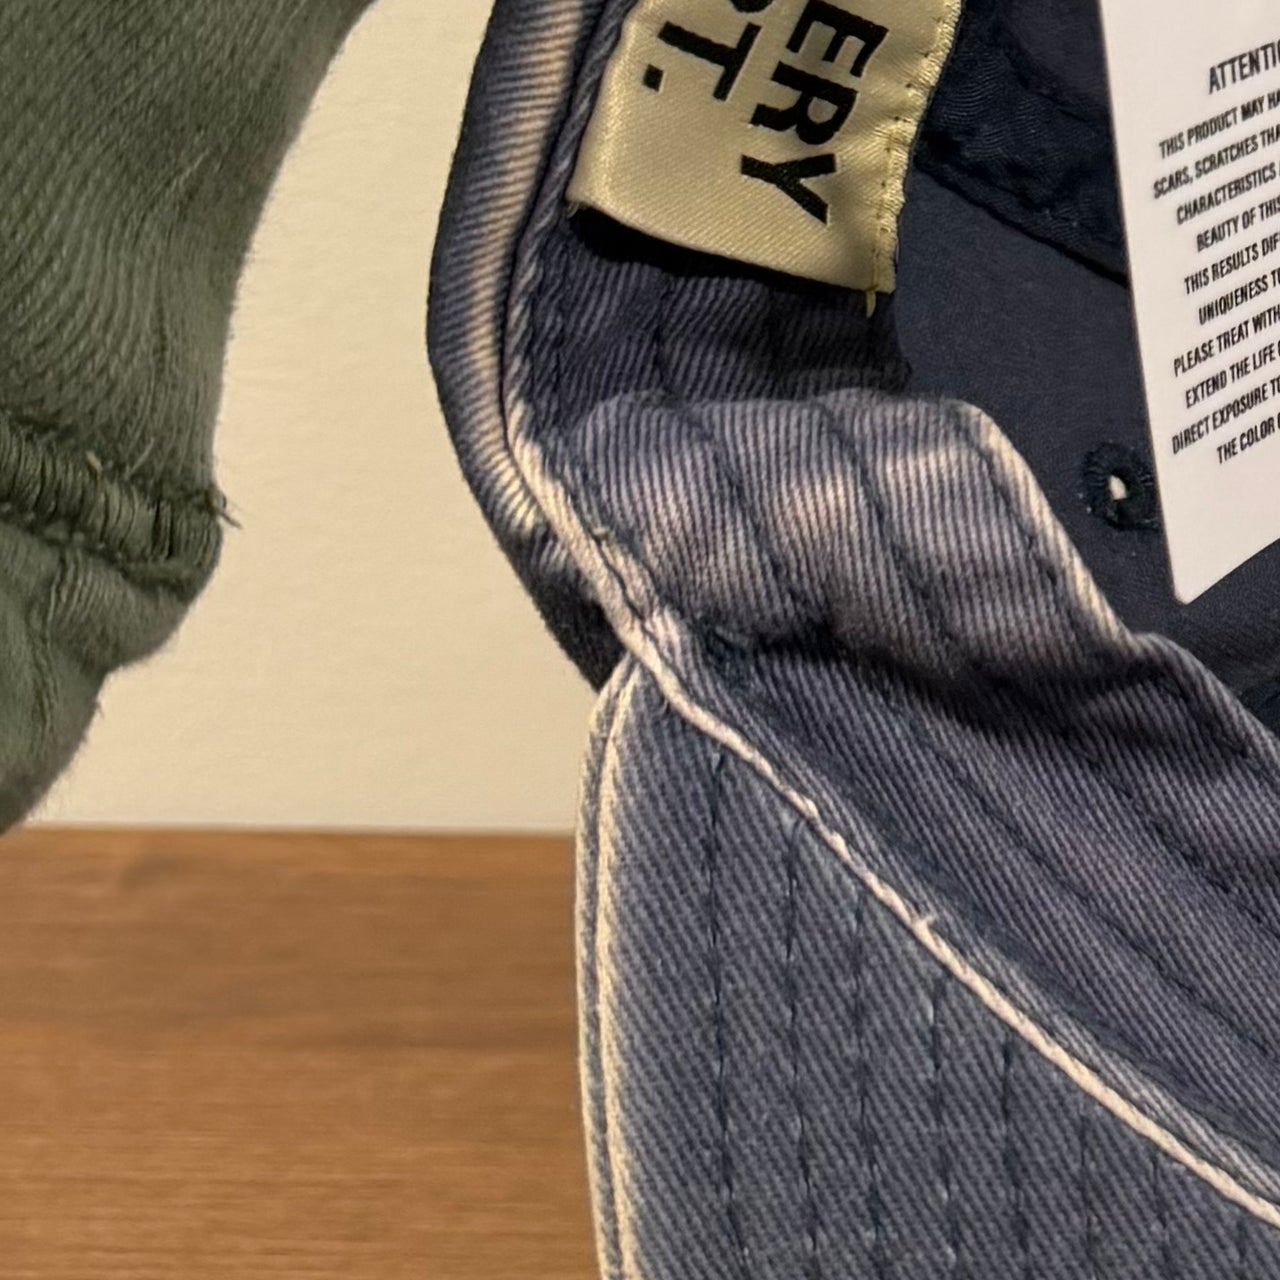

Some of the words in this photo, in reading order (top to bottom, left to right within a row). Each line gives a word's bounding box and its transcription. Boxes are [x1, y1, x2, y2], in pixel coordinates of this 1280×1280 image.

[1159, 132, 1184, 158] THIS
[1187, 107, 1237, 145] PRODUCT
[1240, 96, 1264, 121] MAY
[1153, 166, 1193, 199] SCARS,
[1195, 134, 1258, 178] SCRATCHES
[1177, 162, 1276, 225] CHARACTERISTICS
[1196, 215, 1239, 252] BEAUTY
[1242, 207, 1256, 229] OF
[1184, 267, 1209, 294] THIS
[1211, 242, 1259, 281] RESULTS
[1198, 274, 1268, 325] UNIQUENESS
[1174, 339, 1214, 377] PLEASE
[1216, 319, 1249, 353] TREAT
[1252, 304, 1280, 334] WITH
[1185, 370, 1227, 408] EXTEND
[1229, 357, 1250, 382] THE
[1252, 343, 1275, 370] LIFE
[1172, 415, 1209, 454] DIRECT
[1212, 383, 1268, 430] EXPOSURE
[1217, 437, 1238, 464] THE
[1239, 416, 1275, 451] COLOR
